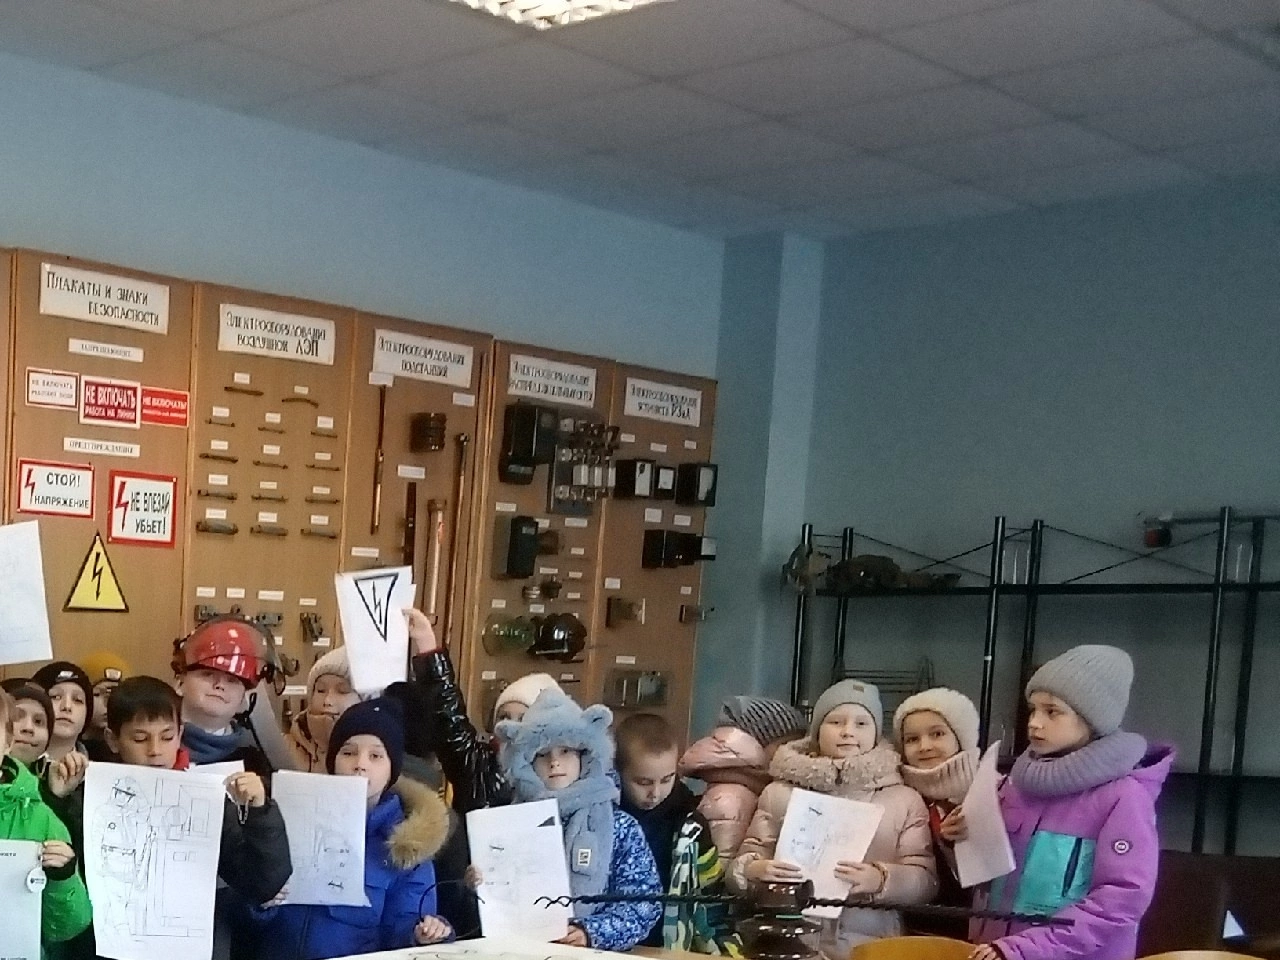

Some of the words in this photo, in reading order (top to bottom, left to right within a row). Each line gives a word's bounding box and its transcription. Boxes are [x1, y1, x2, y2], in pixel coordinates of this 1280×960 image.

[46, 271, 101, 297] ПЛАКАТЫ
[105, 285, 112, 300] И
[116, 287, 149, 306] ЗНАКИ
[88, 301, 160, 326] БЕЗОПАСНОСТИ
[295, 338, 319, 357] ЛЭП
[85, 385, 96, 403] НЕ
[97, 387, 136, 410] ВКЛЮЧАТЬ
[142, 396, 151, 405] НЕ
[46, 472, 81, 488] СТОЙ!
[34, 494, 90, 510] НАПРЯЖЕНИЕ
[130, 491, 141, 512] НЕ
